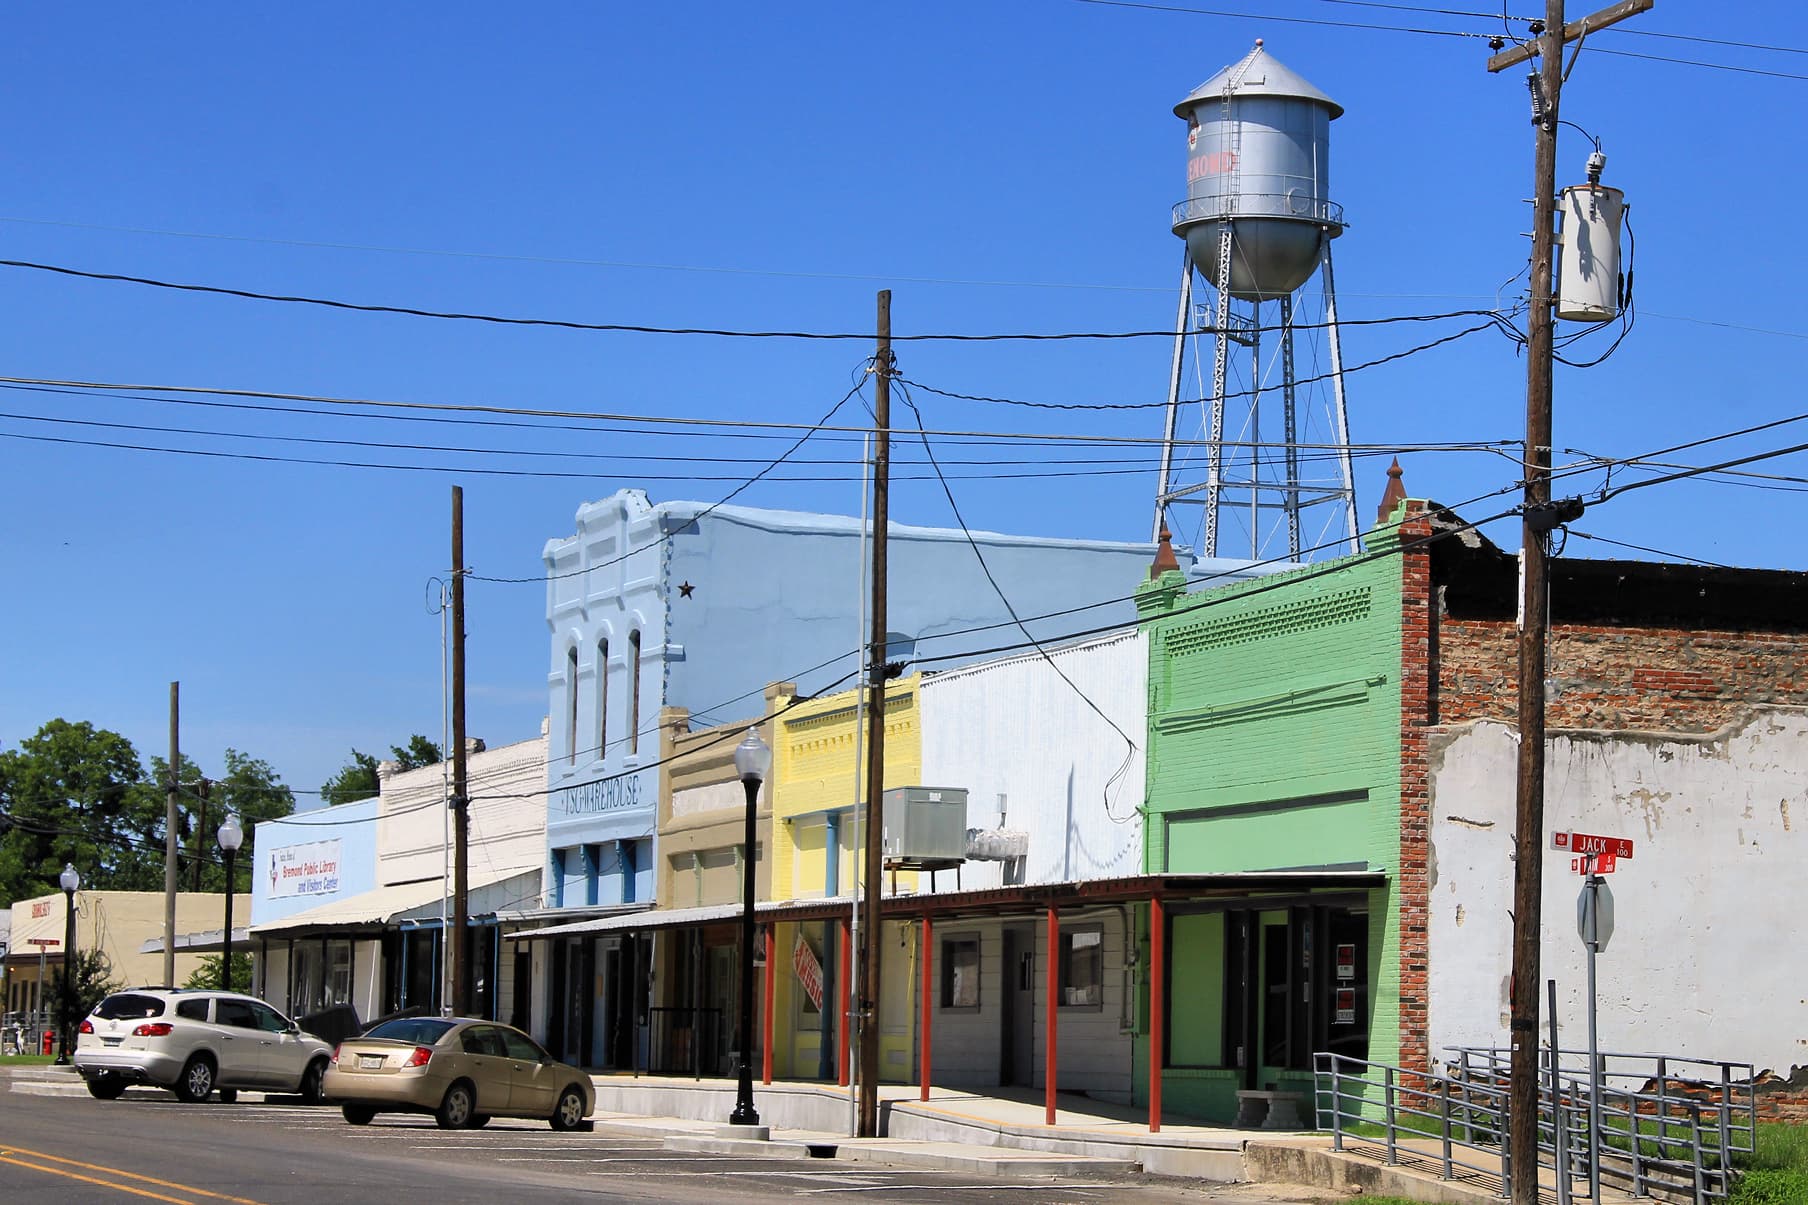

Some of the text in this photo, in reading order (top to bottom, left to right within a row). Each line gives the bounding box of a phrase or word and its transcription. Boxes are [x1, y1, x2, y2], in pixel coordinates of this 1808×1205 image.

[1580, 837, 1606, 853] JACK
[1620, 841, 1625, 849] E
[1616, 849, 1629, 857] 100
[304, 862, 319, 876] Public
[320, 860, 336, 876] Library
[298, 881, 306, 894] and
[323, 876, 339, 891] Center
